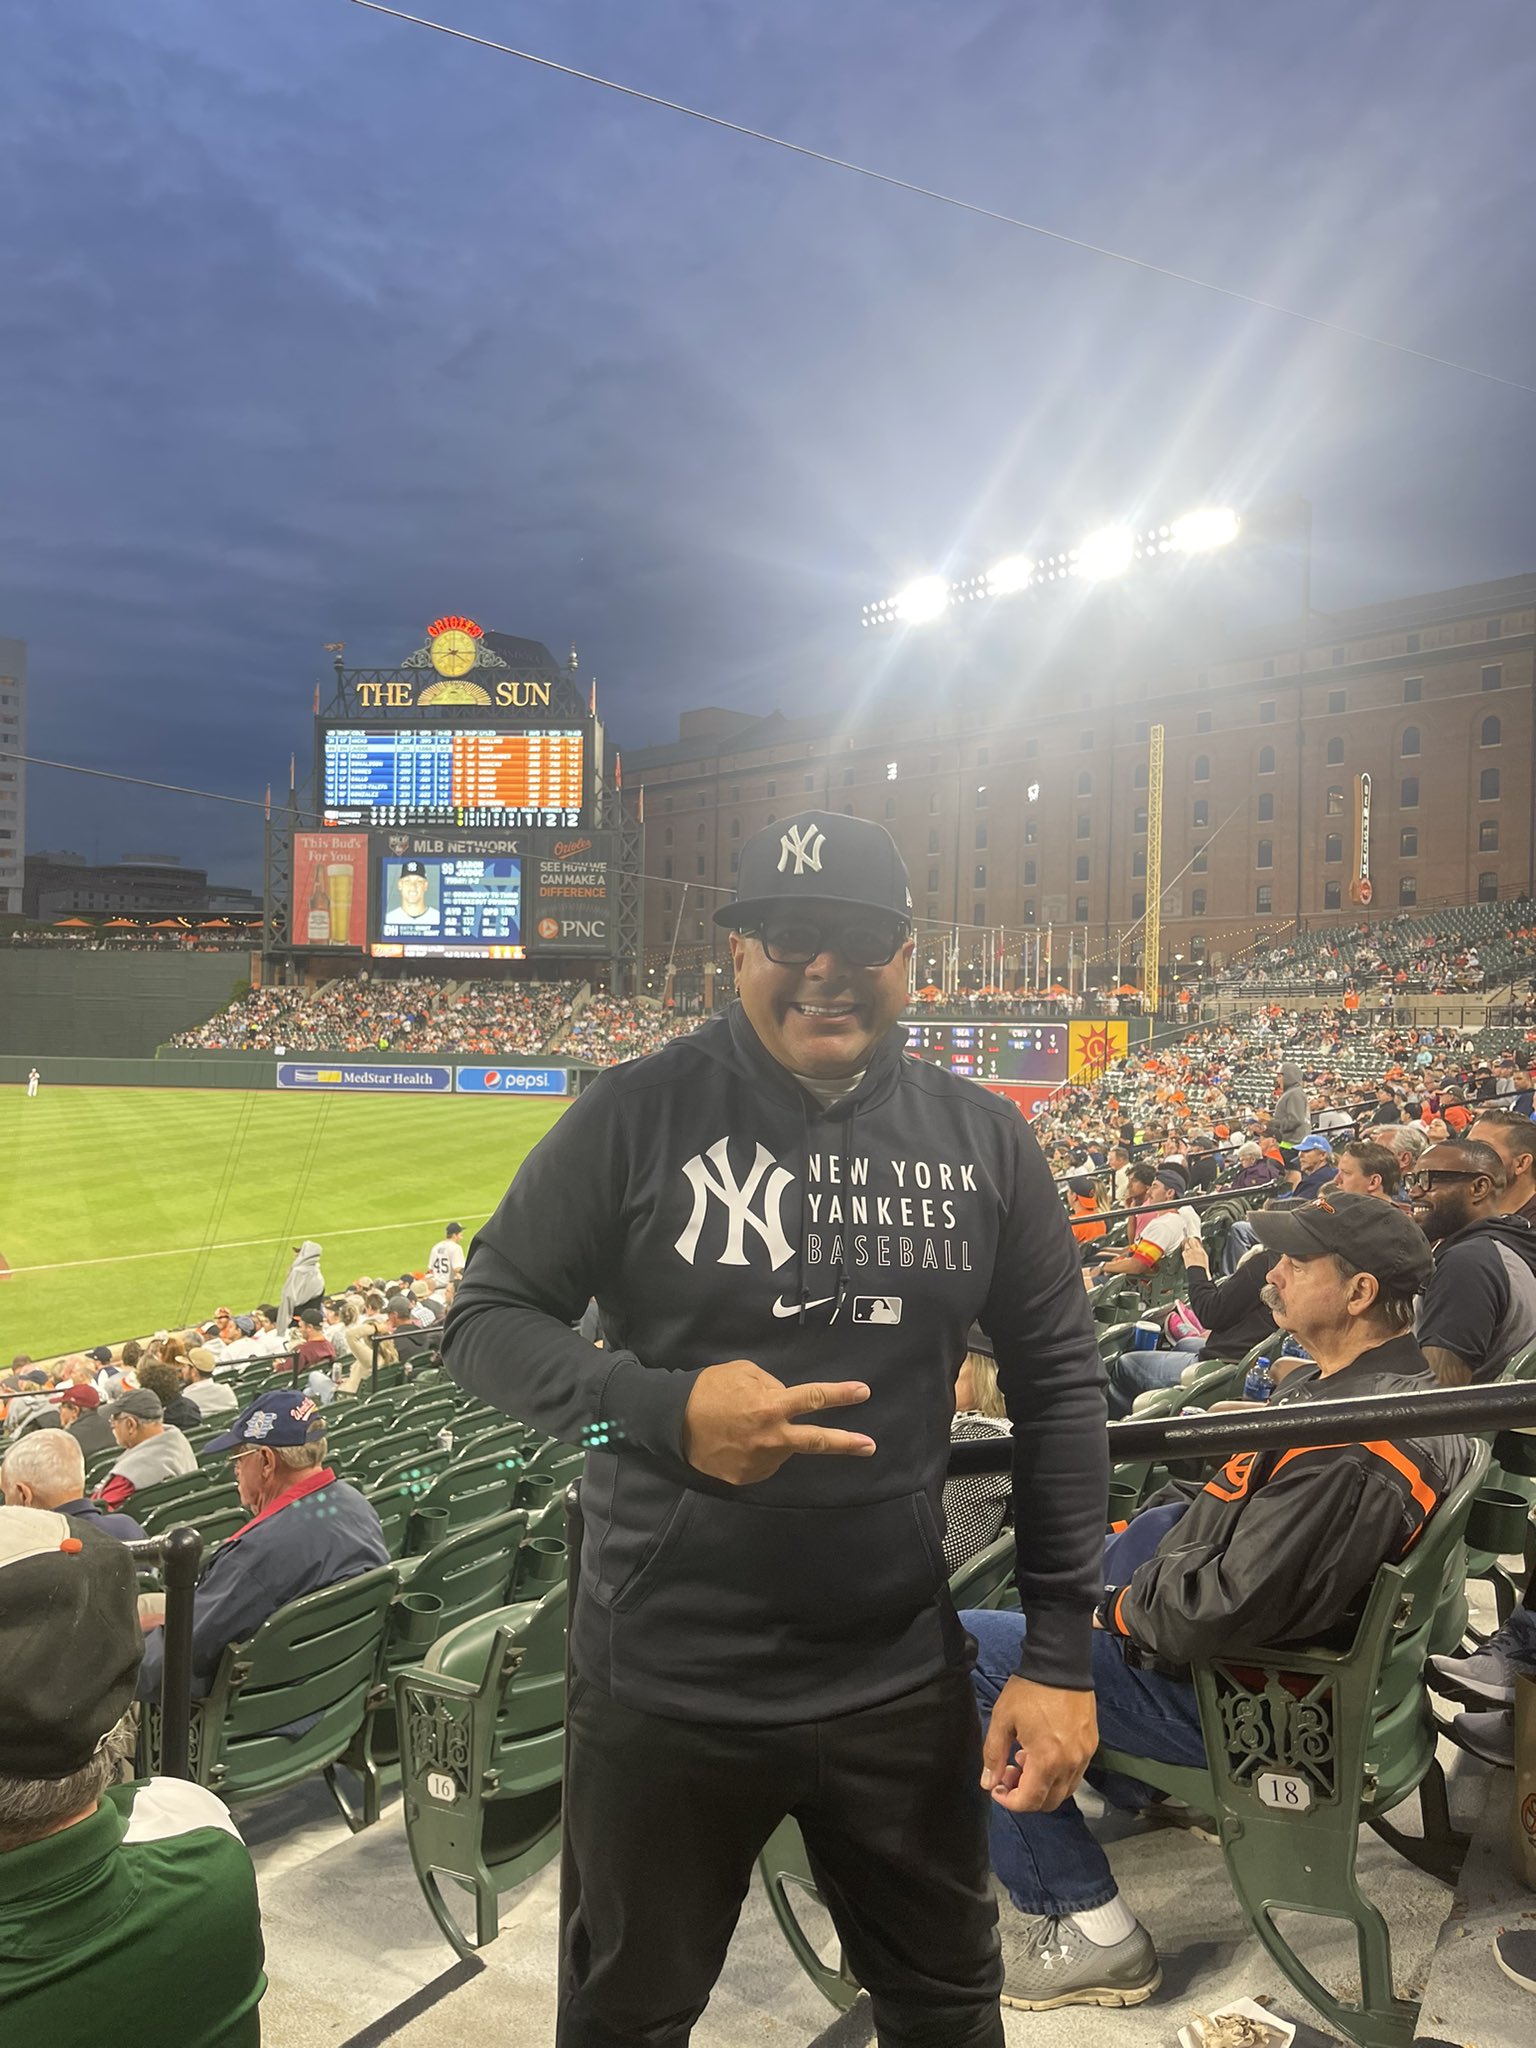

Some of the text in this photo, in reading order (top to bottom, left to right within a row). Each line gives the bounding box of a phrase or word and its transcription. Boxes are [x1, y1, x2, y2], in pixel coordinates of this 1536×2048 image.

[356, 682, 551, 706] THE SUN
[526, 814, 532, 826] 1
[546, 814, 556, 826] 2
[568, 814, 578, 826] 2
[303, 837, 361, 848] This Bud's
[414, 840, 517, 853] MLB NETWORK
[777, 824, 826, 874] NY
[308, 851, 328, 861] For
[442, 863, 454, 875] 99
[540, 862, 560, 872] SEE
[541, 875, 605, 885] CAN MAKE A
[540, 887, 606, 897] DIFFERENCE
[384, 925, 398, 936] DH
[561, 920, 605, 937] PNC
[344, 1072, 432, 1085] MedStar Health
[506, 1072, 548, 1090] pepsi
[808, 1154, 977, 1192] NEW YORK
[674, 1135, 796, 1272] NY
[808, 1194, 956, 1229] YANKEES
[808, 1234, 972, 1271] BASEBALL
[434, 1258, 449, 1274] 45
[436, 1778, 450, 1796] 16
[1271, 1780, 1298, 1804] 18
